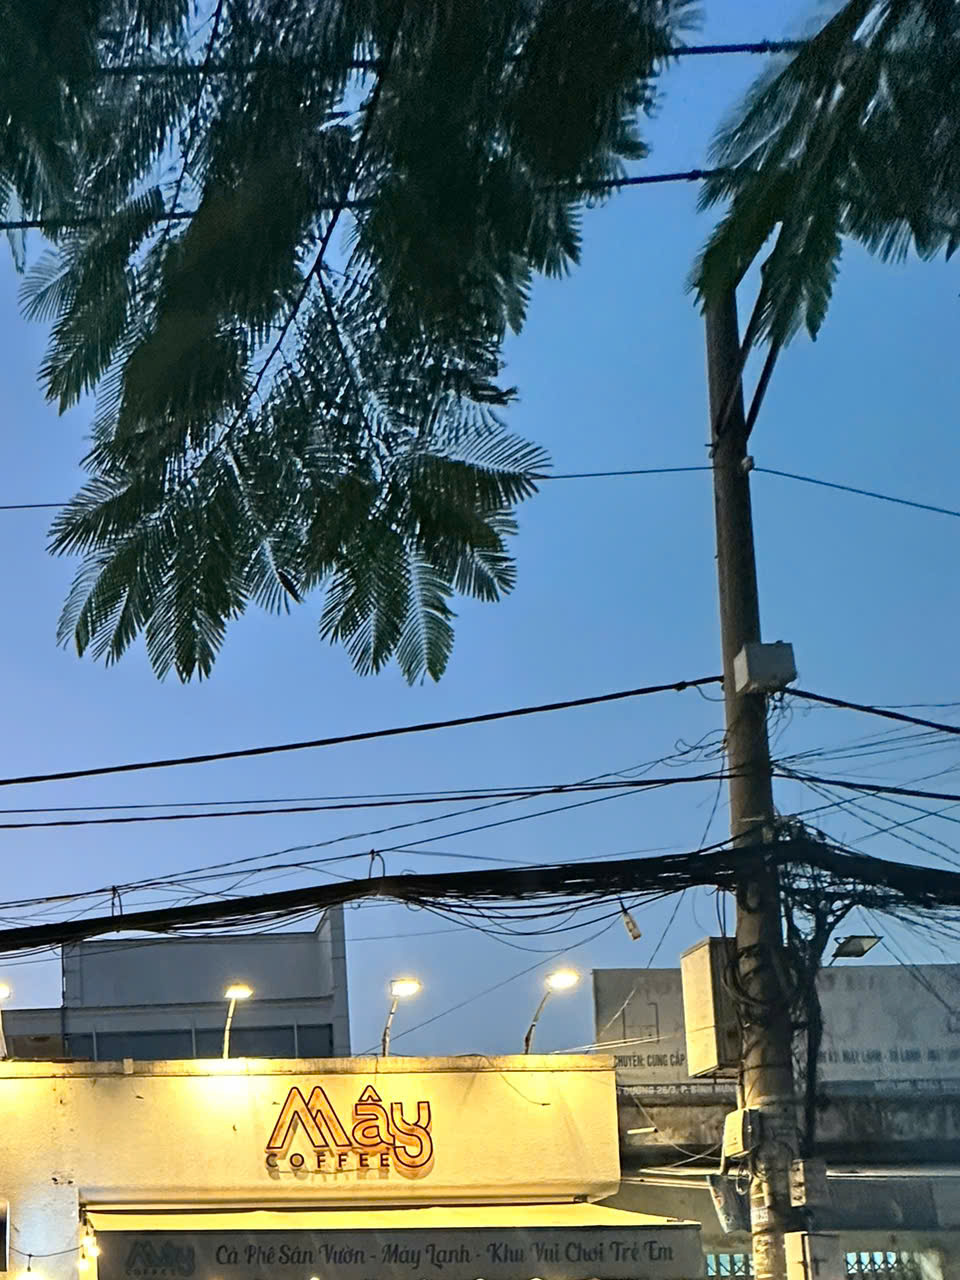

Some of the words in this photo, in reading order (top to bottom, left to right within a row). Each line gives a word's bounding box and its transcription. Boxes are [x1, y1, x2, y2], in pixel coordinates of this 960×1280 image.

[266, 1085, 433, 1168] Mây
[266, 1153, 390, 1168] COFFEE
[216, 1244, 238, 1265] Cà
[382, 1243, 421, 1269] Máy
[486, 1242, 524, 1263] Khu
[643, 1240, 673, 1261] Em
